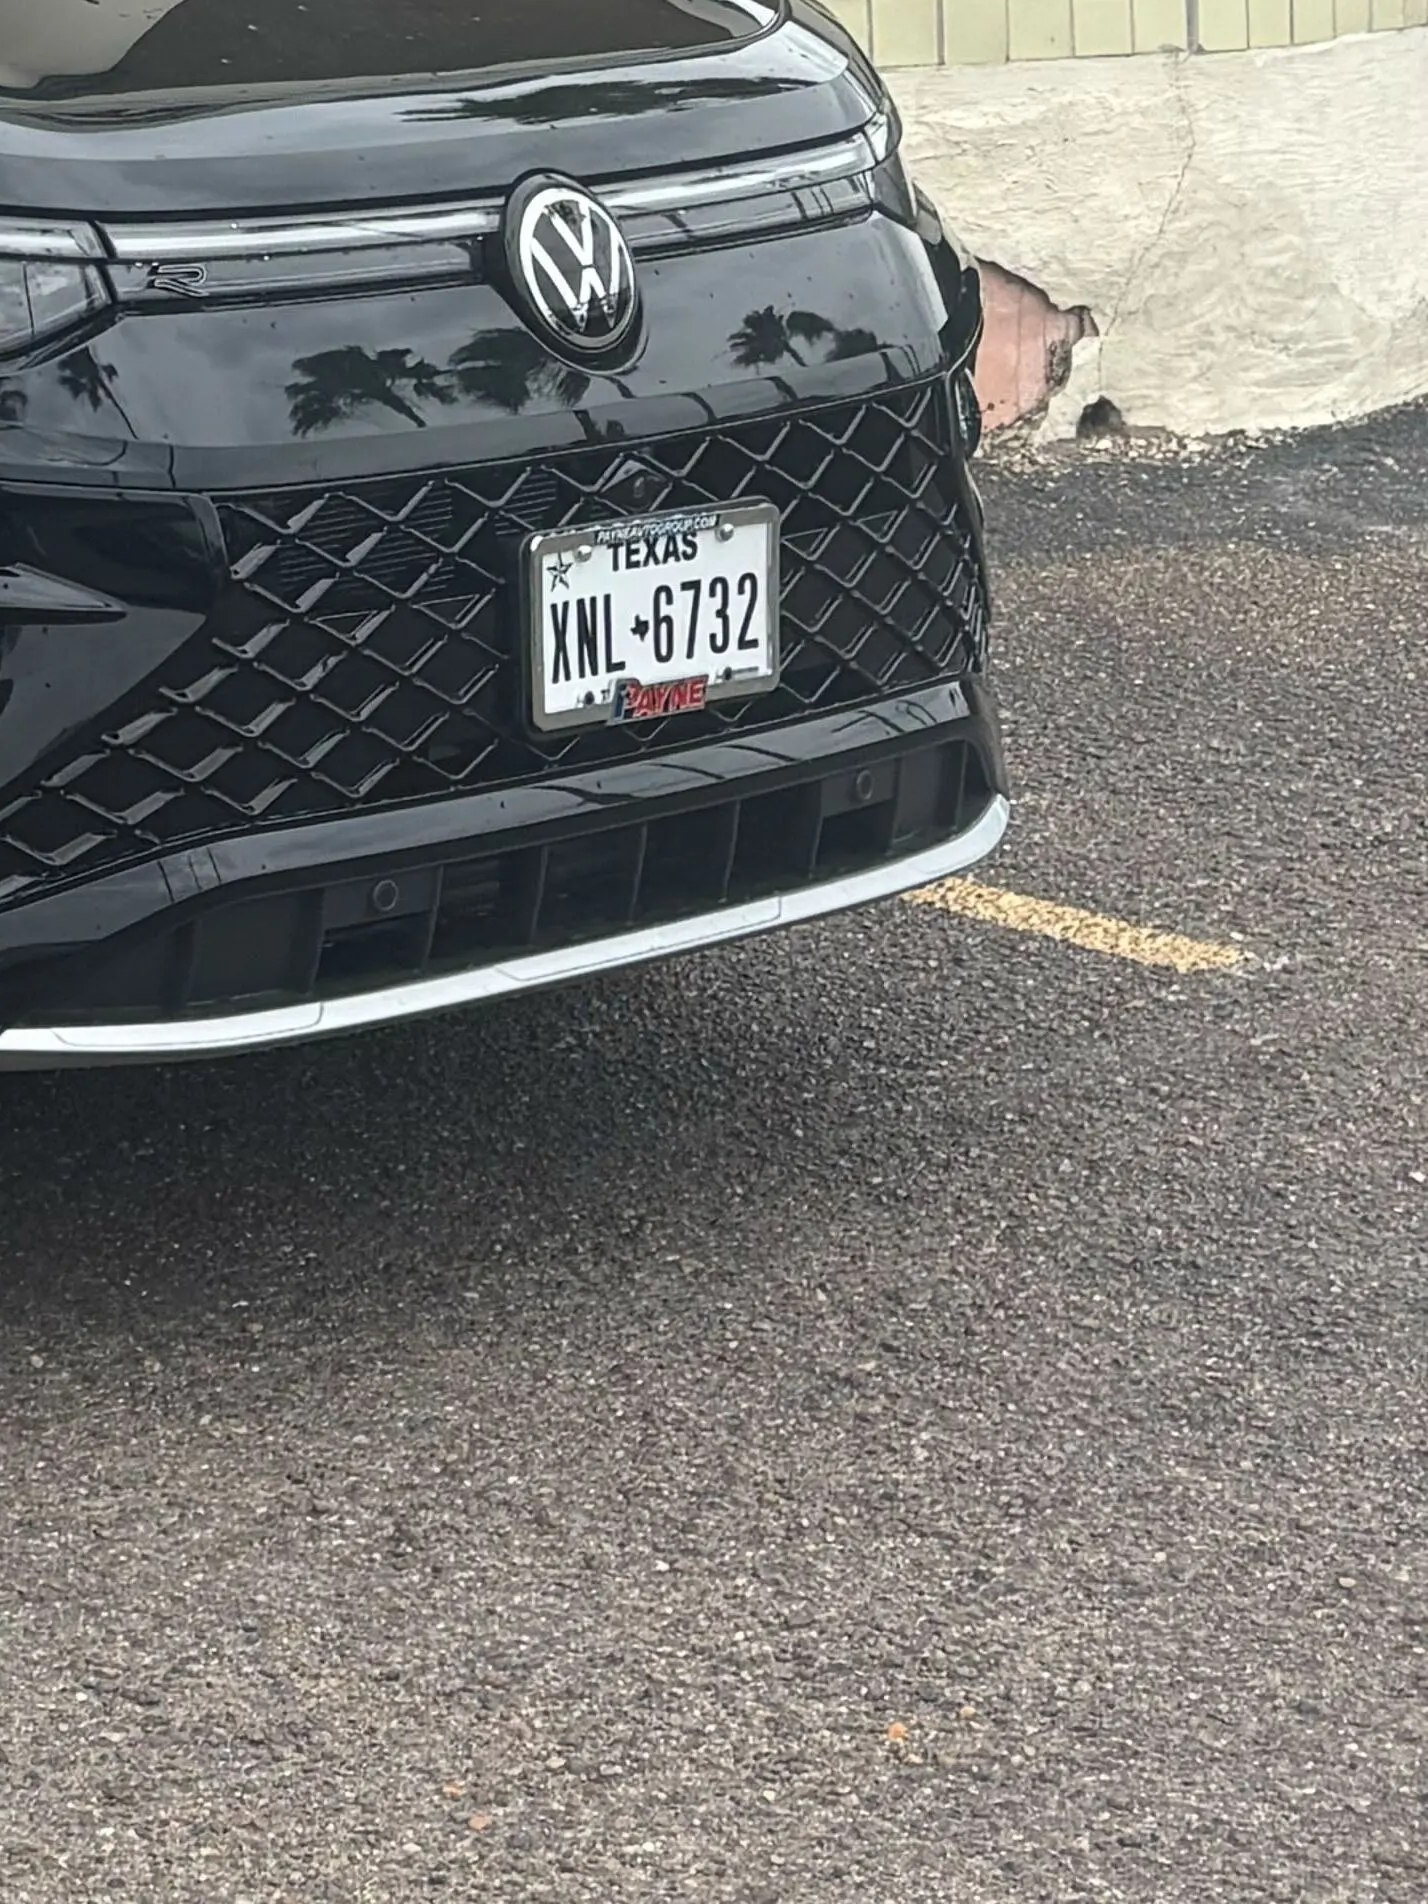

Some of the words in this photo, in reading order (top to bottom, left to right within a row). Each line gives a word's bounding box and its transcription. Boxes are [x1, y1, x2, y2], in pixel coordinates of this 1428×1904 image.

[608, 532, 698, 571] TEXAS
[550, 594, 626, 684] XNL
[652, 572, 759, 663] 6732
[611, 679, 706, 722] PAYNE
